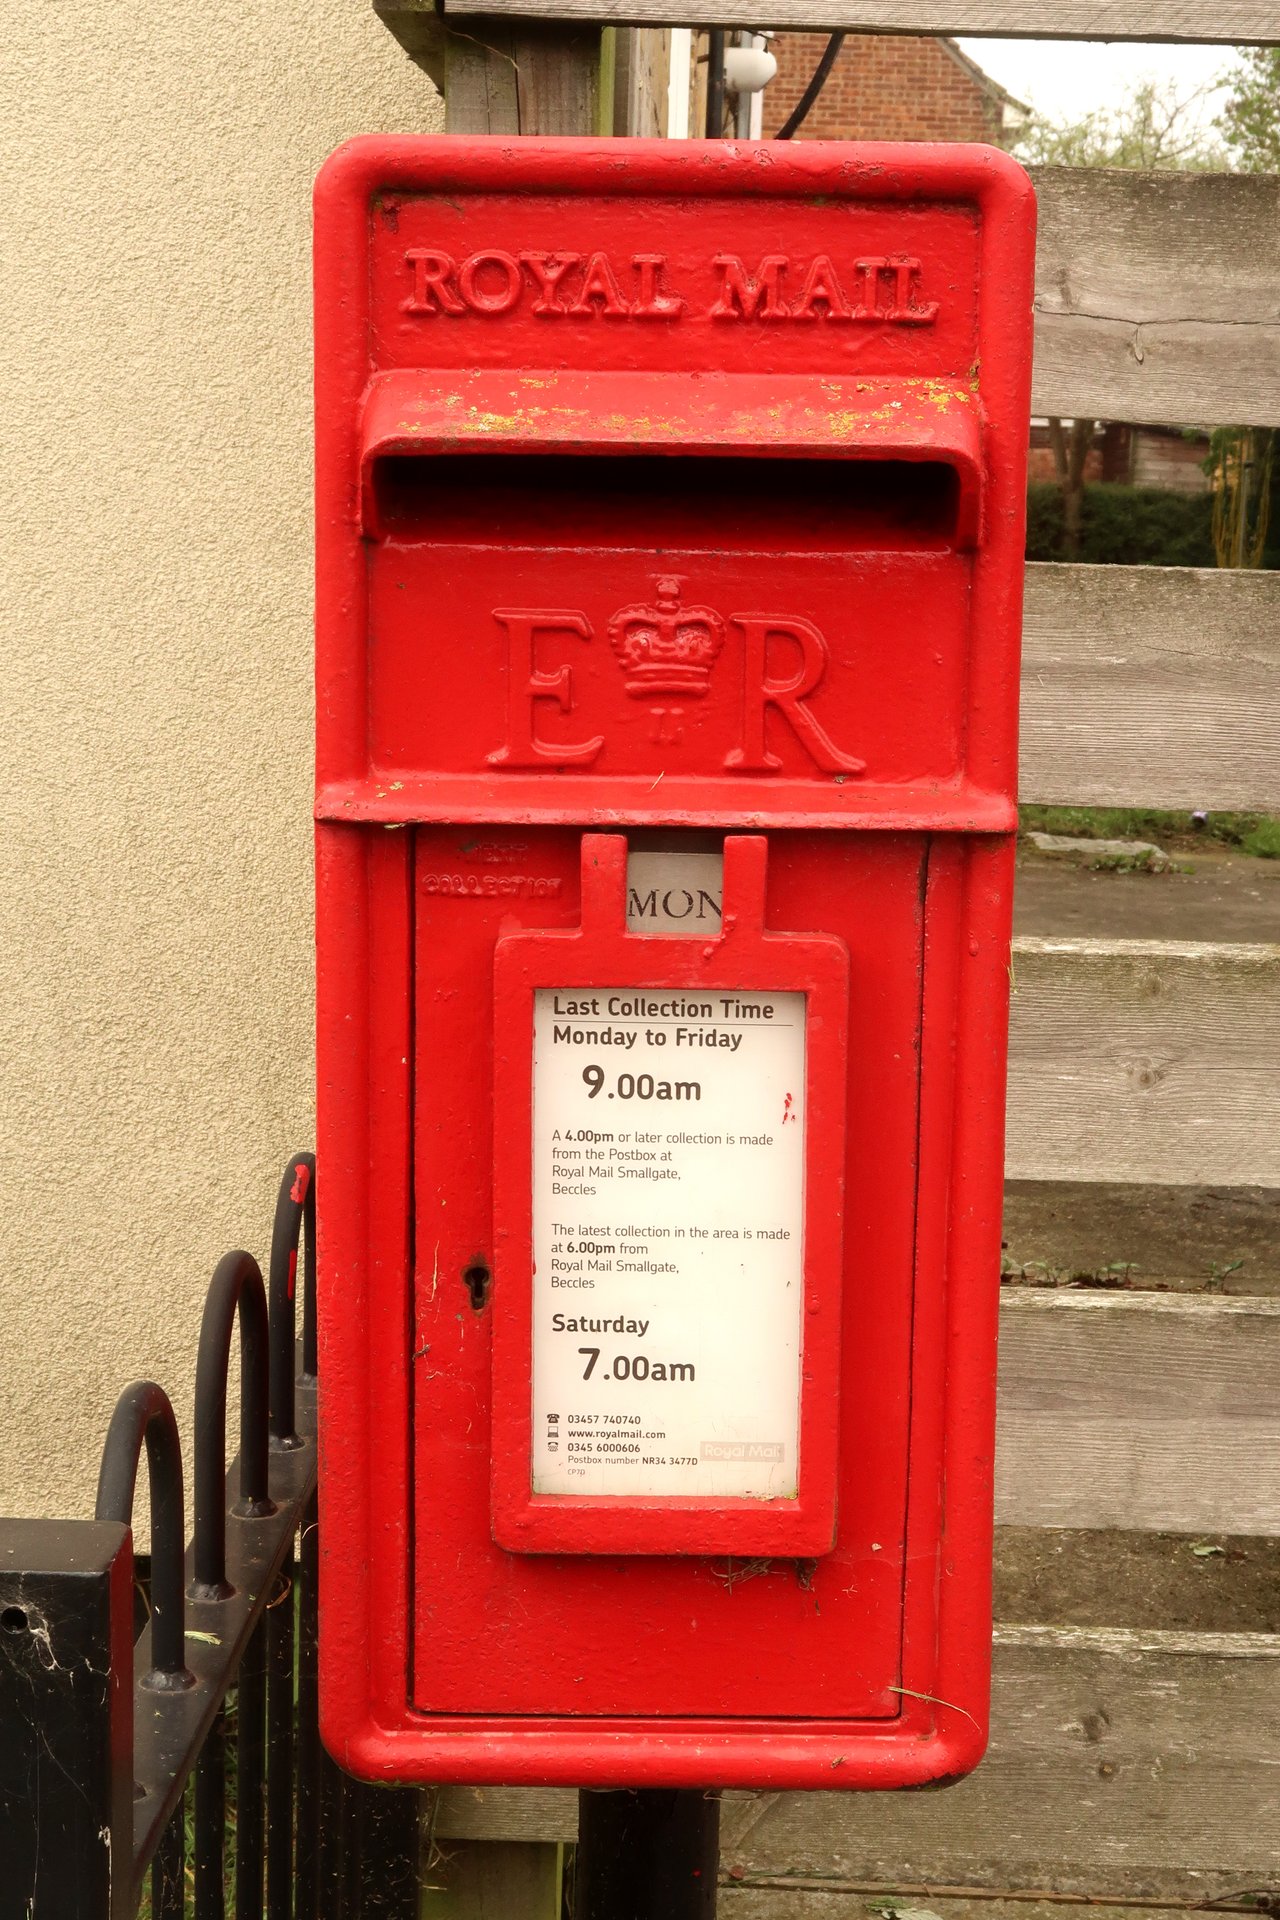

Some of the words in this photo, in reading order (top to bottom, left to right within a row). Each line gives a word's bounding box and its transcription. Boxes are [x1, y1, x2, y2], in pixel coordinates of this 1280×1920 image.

[402, 247, 683, 318] ROYAL
[710, 253, 939, 326] MAIL
[485, 607, 604, 768] E
[723, 612, 867, 774] R
[628, 888, 722, 919] MON
[553, 995, 600, 1015] Last
[608, 995, 713, 1017] Collection
[720, 997, 775, 1019] Time
[554, 1025, 637, 1049] Monday
[645, 1029, 666, 1046] to
[676, 1028, 742, 1051] Friday
[582, 1065, 700, 1100] 9.00am
[552, 1130, 562, 1142] A
[565, 1130, 614, 1145] 4.00pm
[618, 1134, 632, 1143] or
[635, 1132, 663, 1144] later
[667, 1132, 722, 1145] collection
[727, 1133, 736, 1145] is
[740, 1134, 774, 1146] made
[552, 1147, 581, 1160] from
[586, 1148, 605, 1161] the
[610, 1148, 657, 1161] Postbox
[660, 1151, 673, 1162] at
[553, 1165, 585, 1180] Royal
[589, 1166, 614, 1178] Mail
[618, 1166, 681, 1182] Smallgate,
[553, 1183, 597, 1196] Beccles
[551, 1224, 575, 1236] The
[579, 1225, 612, 1237] latest
[615, 1225, 671, 1238] collection
[675, 1226, 686, 1238] in
[690, 1227, 709, 1239] the
[712, 1230, 739, 1239] area
[744, 1228, 753, 1240] is
[757, 1228, 791, 1241] made
[551, 1243, 564, 1254] at
[567, 1242, 616, 1256] 6.00pm
[620, 1243, 649, 1255] from
[552, 1259, 584, 1274] Royal
[588, 1260, 612, 1272] Mail
[616, 1260, 679, 1275] Smallgate,
[551, 1276, 596, 1289] Beccles
[552, 1314, 649, 1337] Saturday
[578, 1348, 695, 1381] 7.00am
[567, 1415, 600, 1424] 03457
[602, 1416, 641, 1425] 740740
[567, 1430, 666, 1440] www.royalmail.com
[567, 1443, 593, 1452] 0345
[596, 1444, 641, 1453] 6000606
[704, 1443, 745, 1459] Royal
[567, 1455, 603, 1464] Postbox
[605, 1457, 640, 1465] number
[642, 1457, 666, 1465] NR34
[669, 1457, 698, 1466] 3477D
